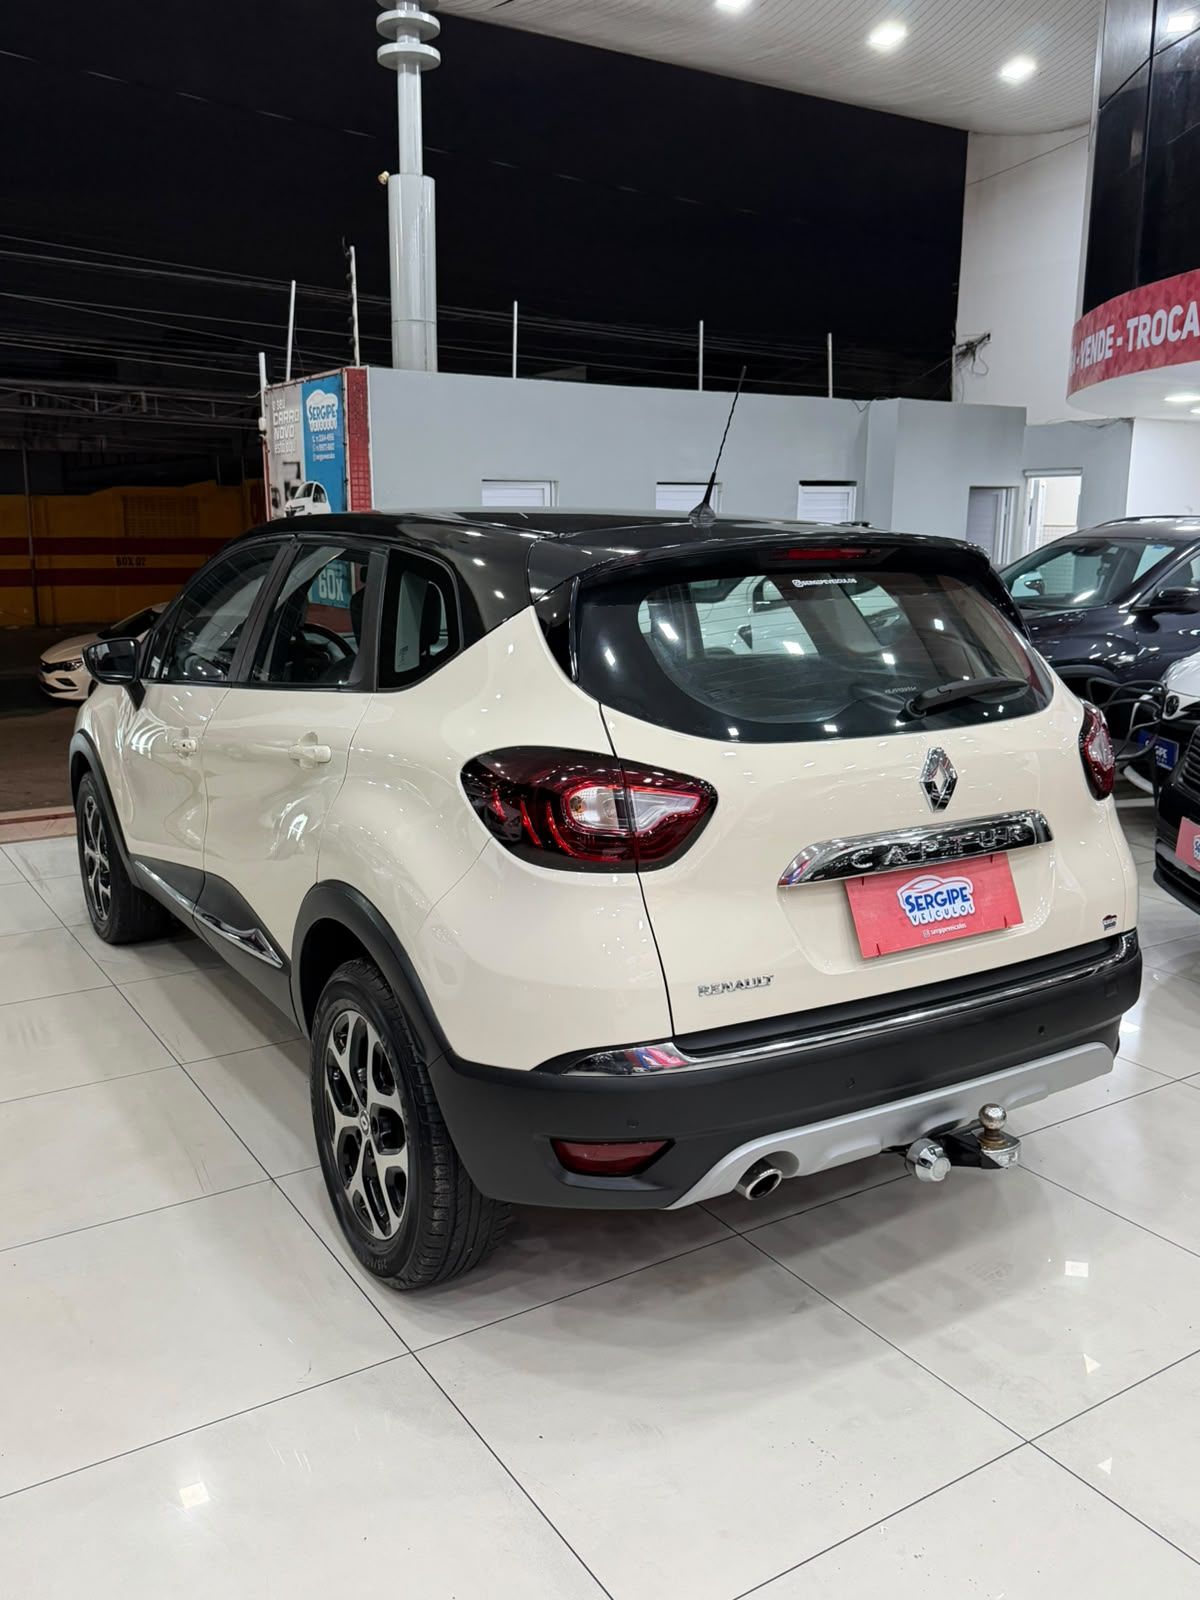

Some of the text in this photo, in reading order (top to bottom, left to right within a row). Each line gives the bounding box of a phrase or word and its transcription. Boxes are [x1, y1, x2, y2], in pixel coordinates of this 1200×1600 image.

[1081, 325, 1115, 370] VENDE
[1126, 301, 1200, 352] TROCA
[272, 409, 300, 426] CARRO
[308, 404, 337, 420] SERGIPE
[274, 424, 295, 440] NOVO
[849, 824, 1026, 869] CAPTUR
[904, 886, 971, 914] SERGIPE
[697, 975, 774, 997] RENAULT
